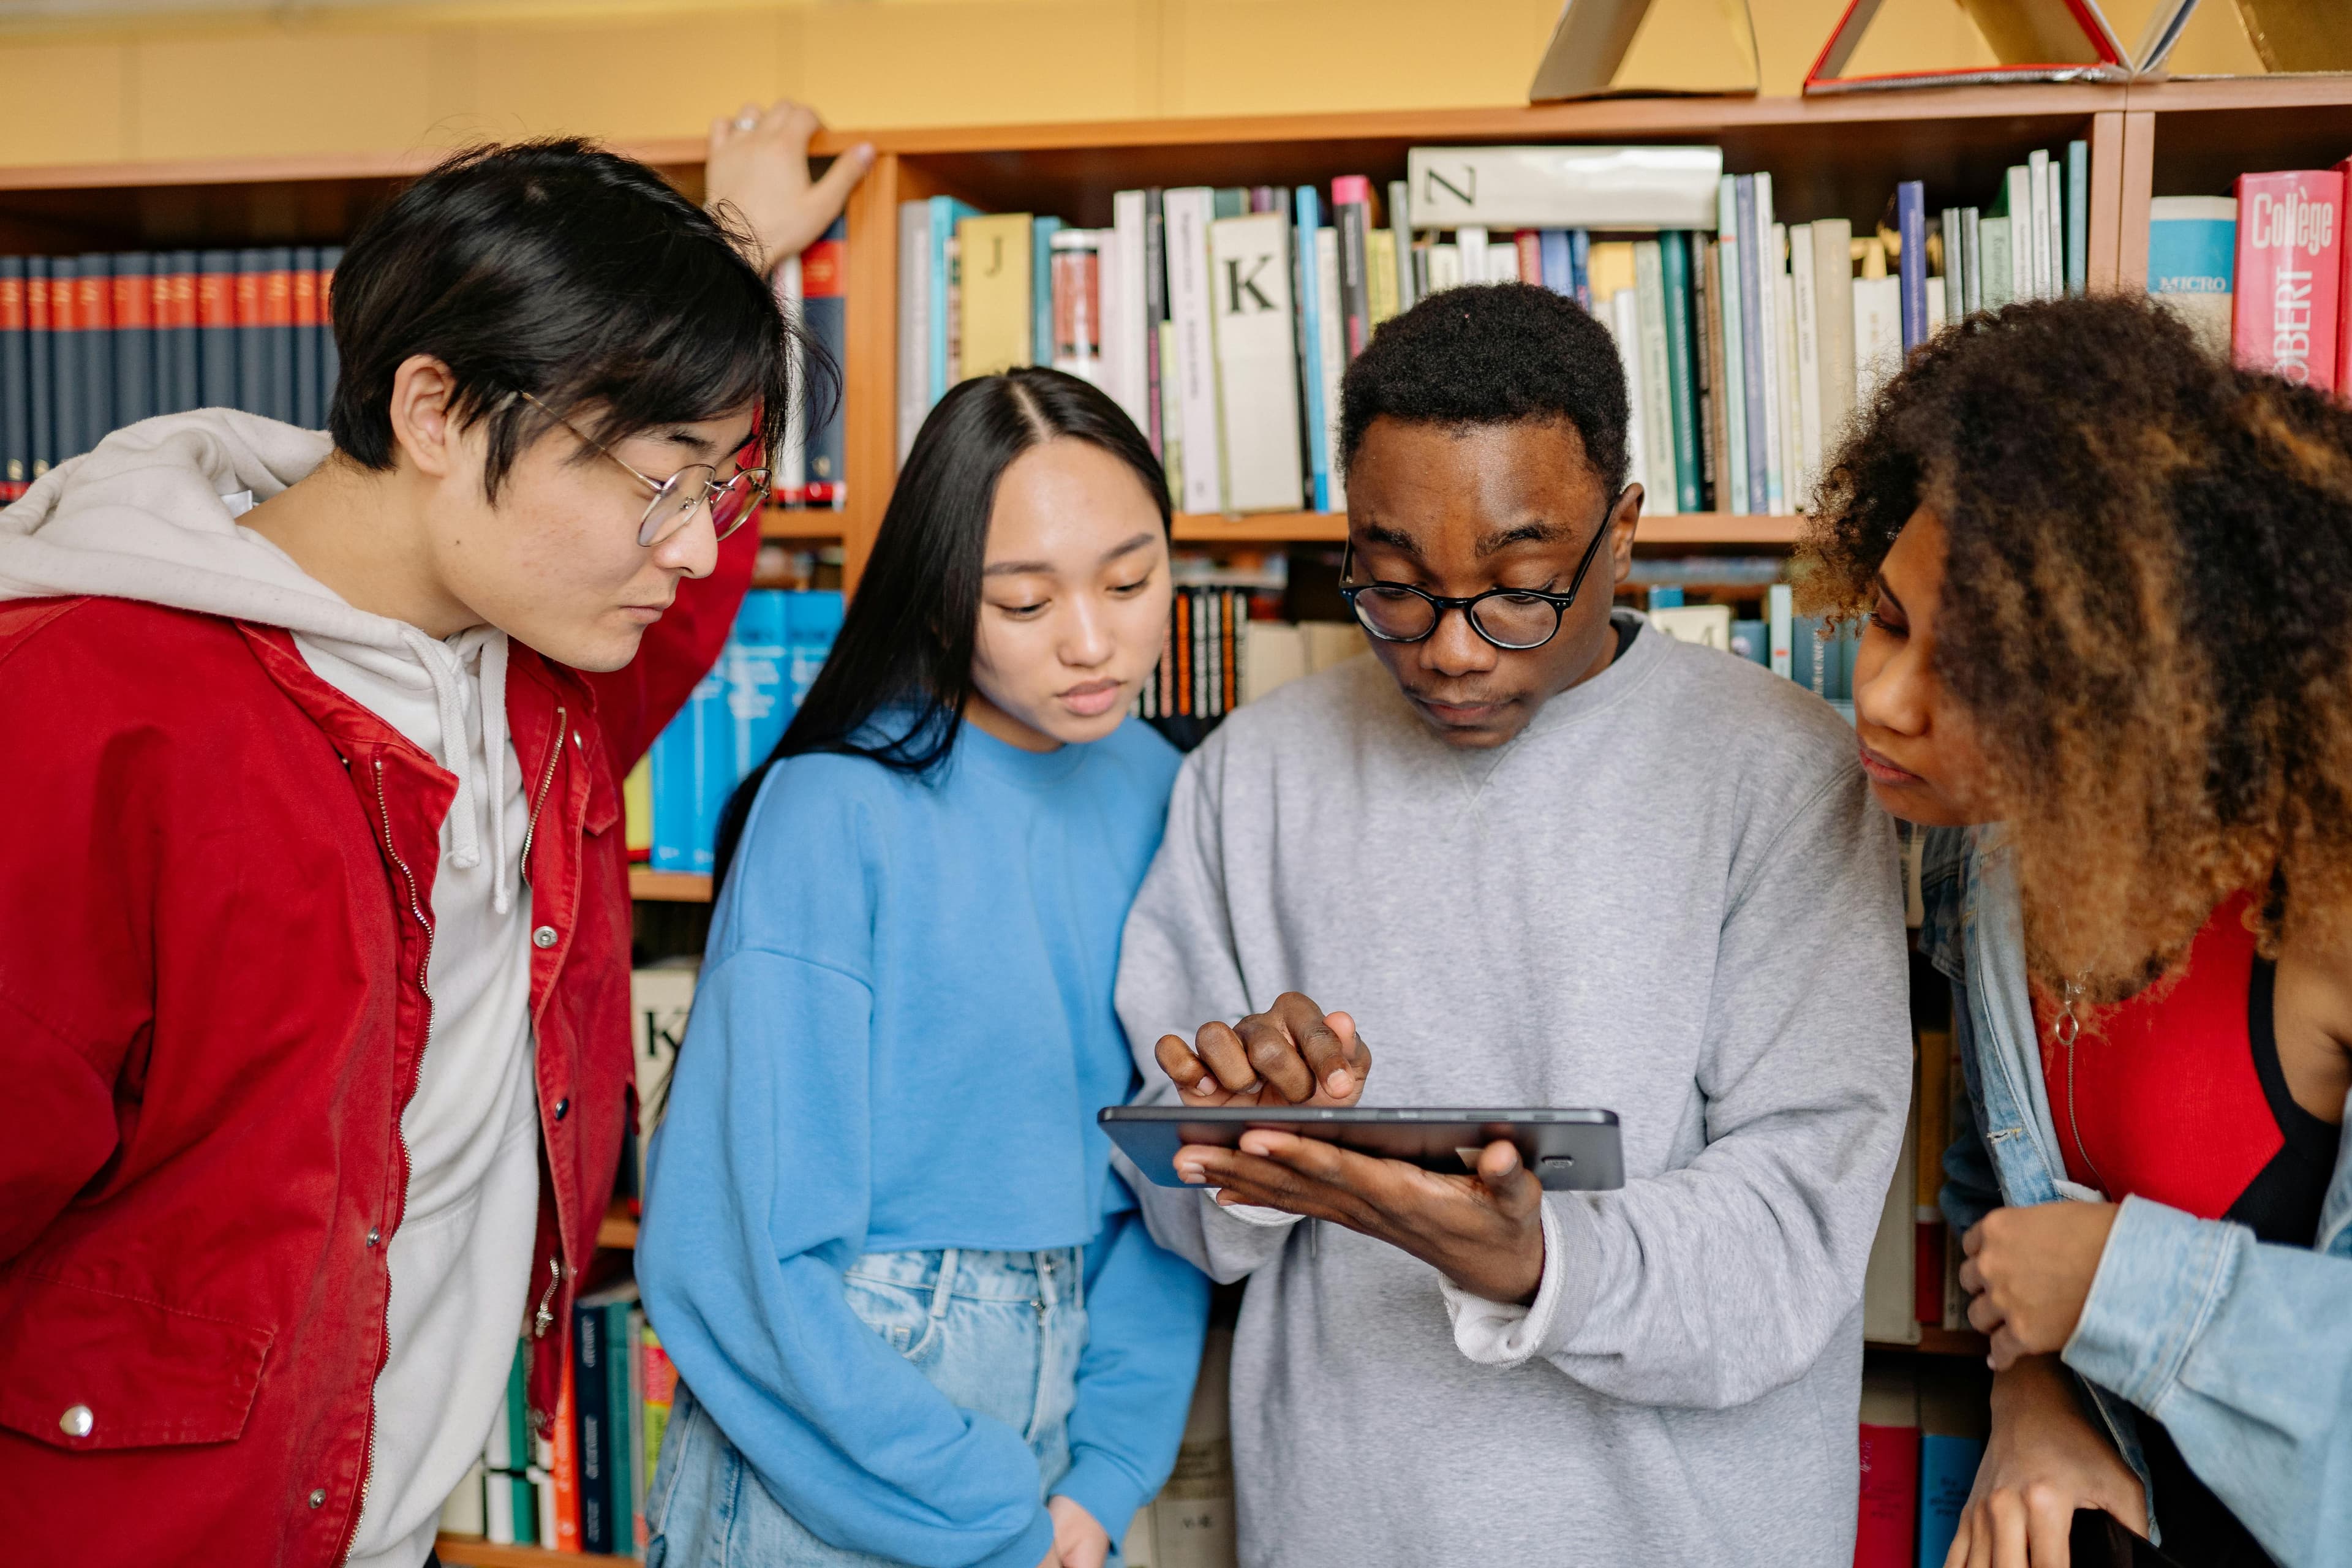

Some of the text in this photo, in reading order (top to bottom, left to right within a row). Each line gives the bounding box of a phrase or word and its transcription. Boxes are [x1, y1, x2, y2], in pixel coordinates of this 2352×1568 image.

[1424, 164, 1476, 207] N
[2251, 186, 2334, 256] Collège
[982, 236, 1003, 278] J
[1223, 254, 1278, 314] K
[2158, 276, 2226, 294] MICRO
[2272, 266, 2313, 387] OBERT
